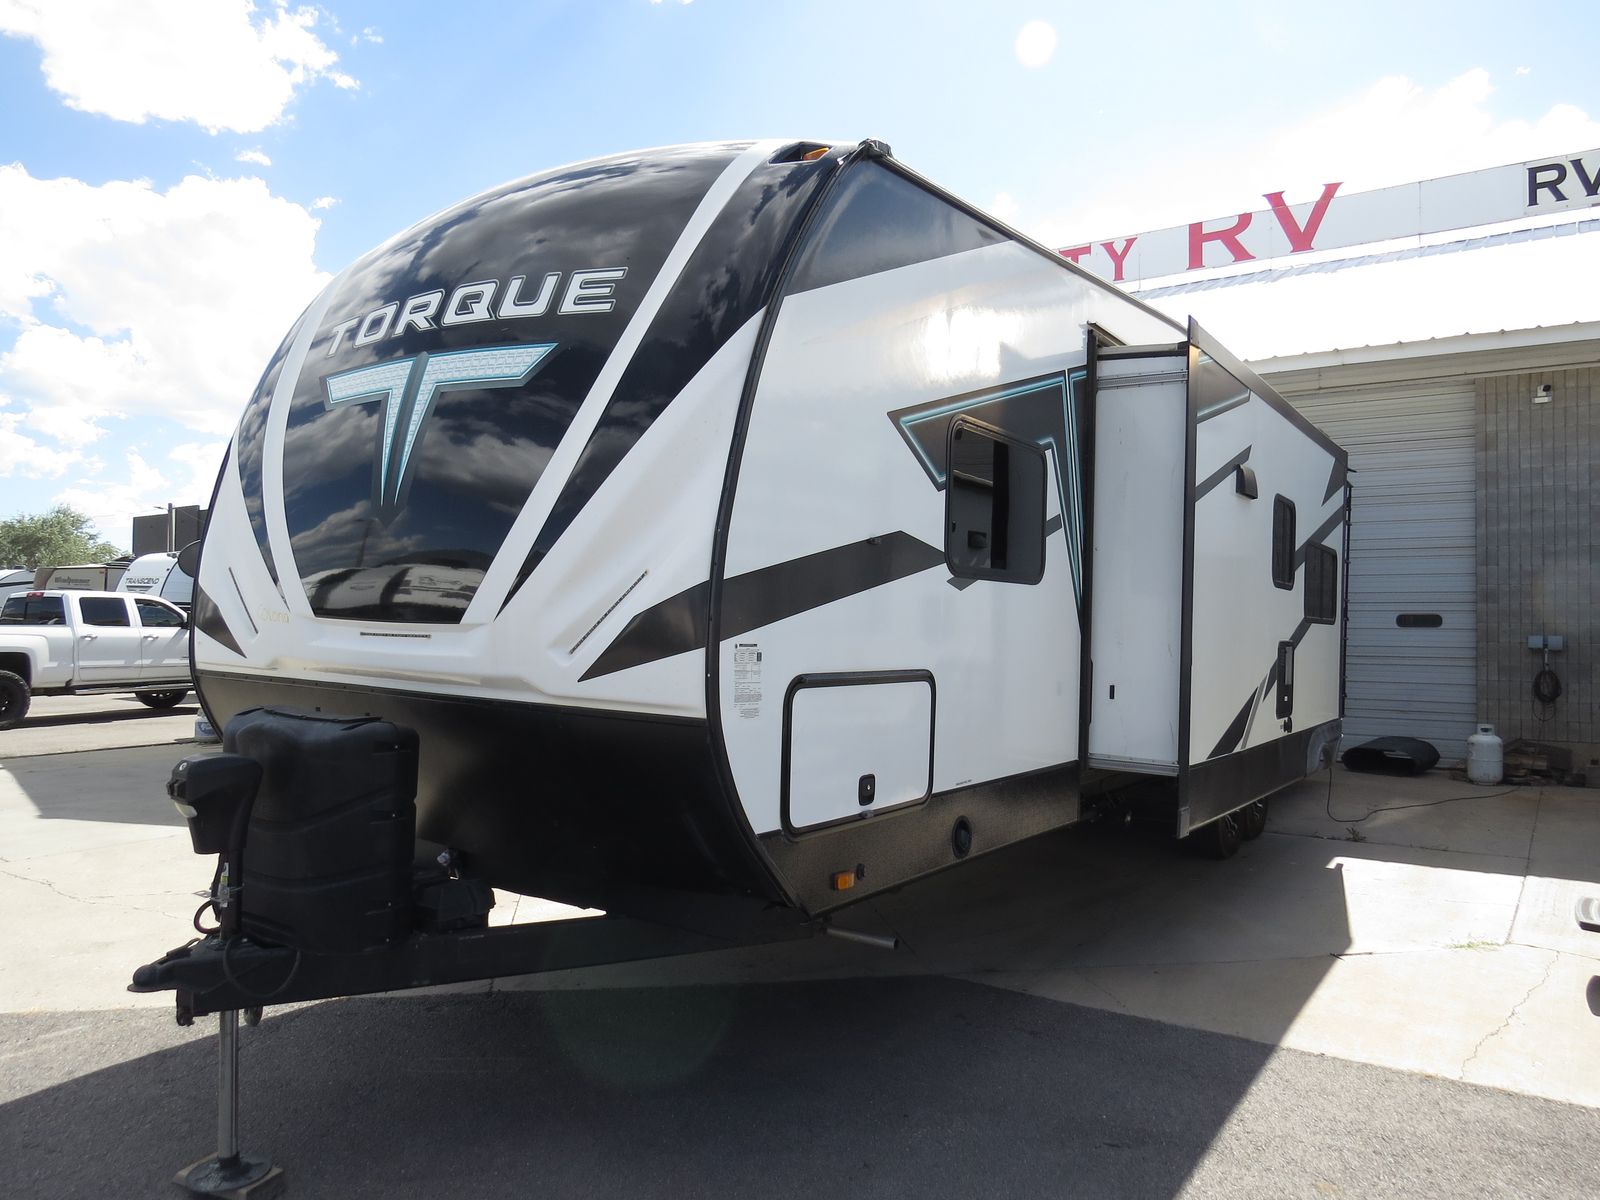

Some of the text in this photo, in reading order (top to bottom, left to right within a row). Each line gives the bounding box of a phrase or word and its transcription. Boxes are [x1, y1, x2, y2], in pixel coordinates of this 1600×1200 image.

[1186, 181, 1344, 270] RV
[1526, 158, 1600, 207] RV
[326, 266, 629, 358] TORQUE
